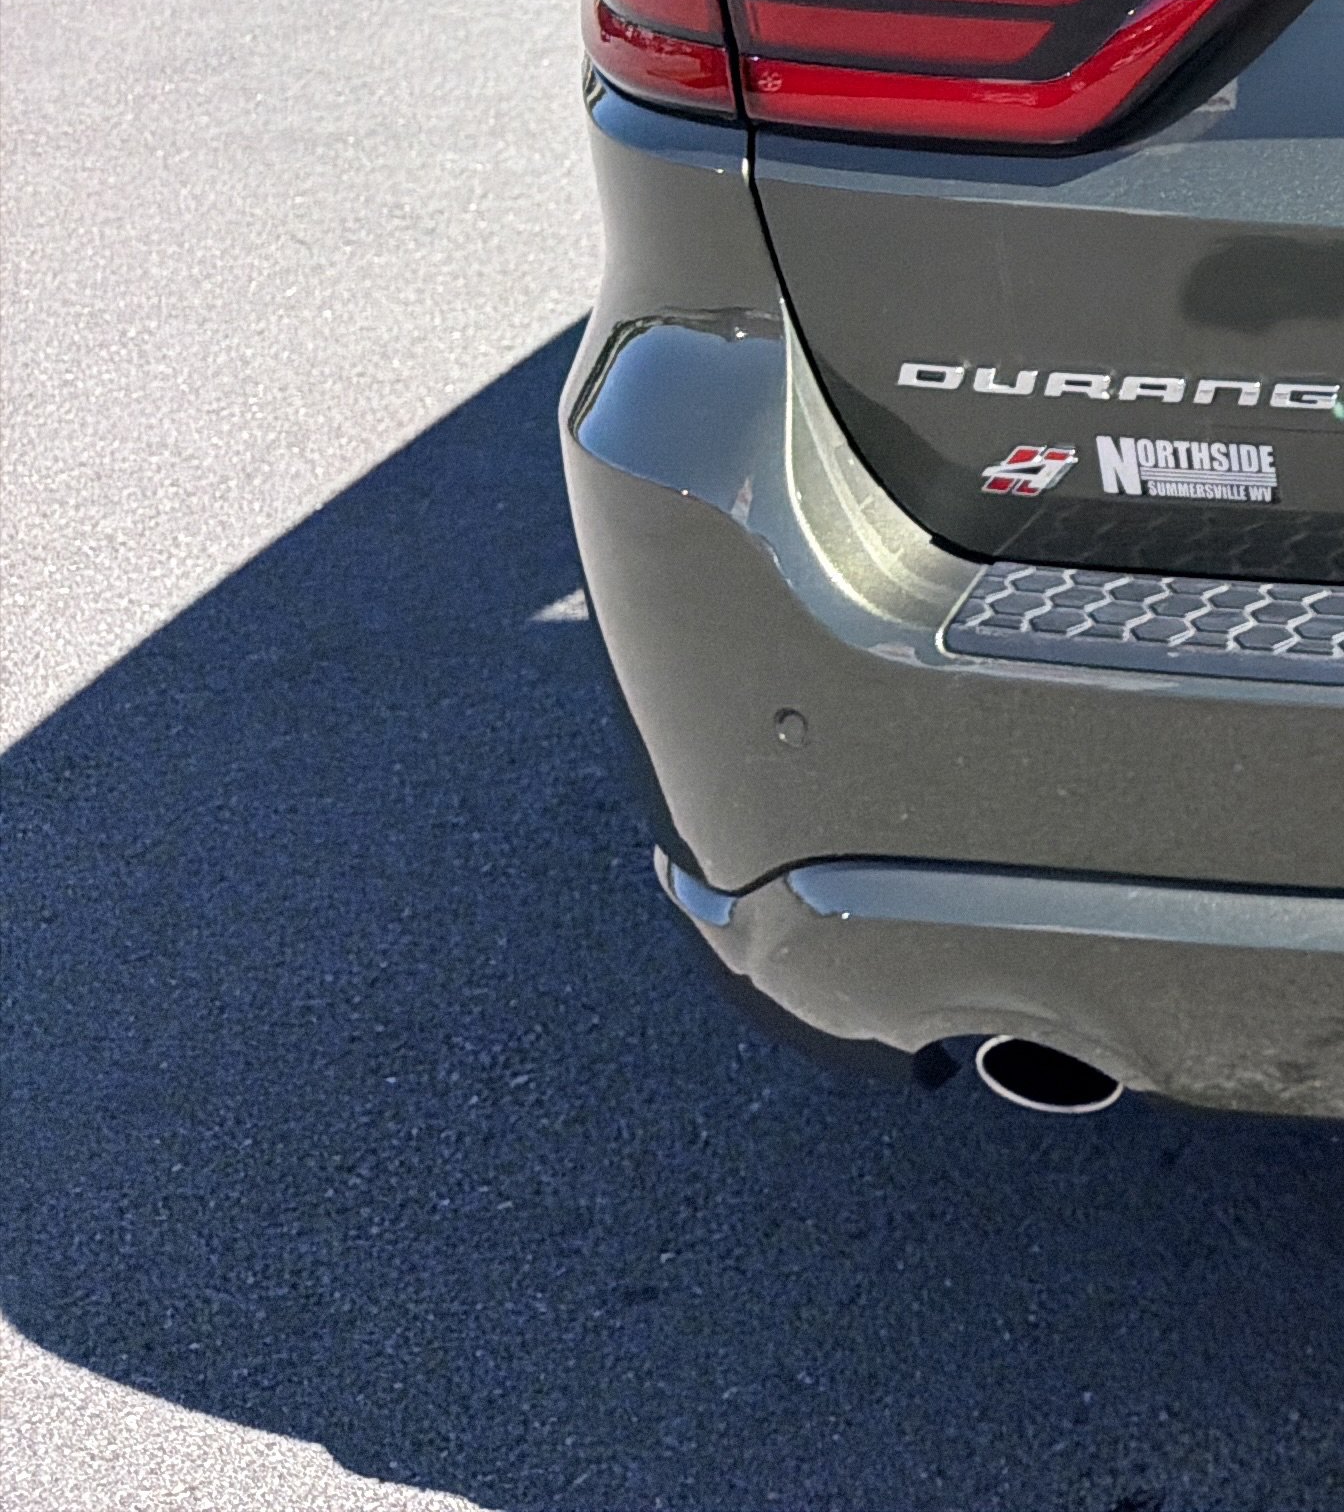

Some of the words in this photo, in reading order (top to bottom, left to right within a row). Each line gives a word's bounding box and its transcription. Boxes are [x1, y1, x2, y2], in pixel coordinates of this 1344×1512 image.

[1095, 435, 1276, 495] NORTHSIDE
[1147, 480, 1248, 501] SUMMERSVILLE
[1248, 486, 1272, 503] WV
